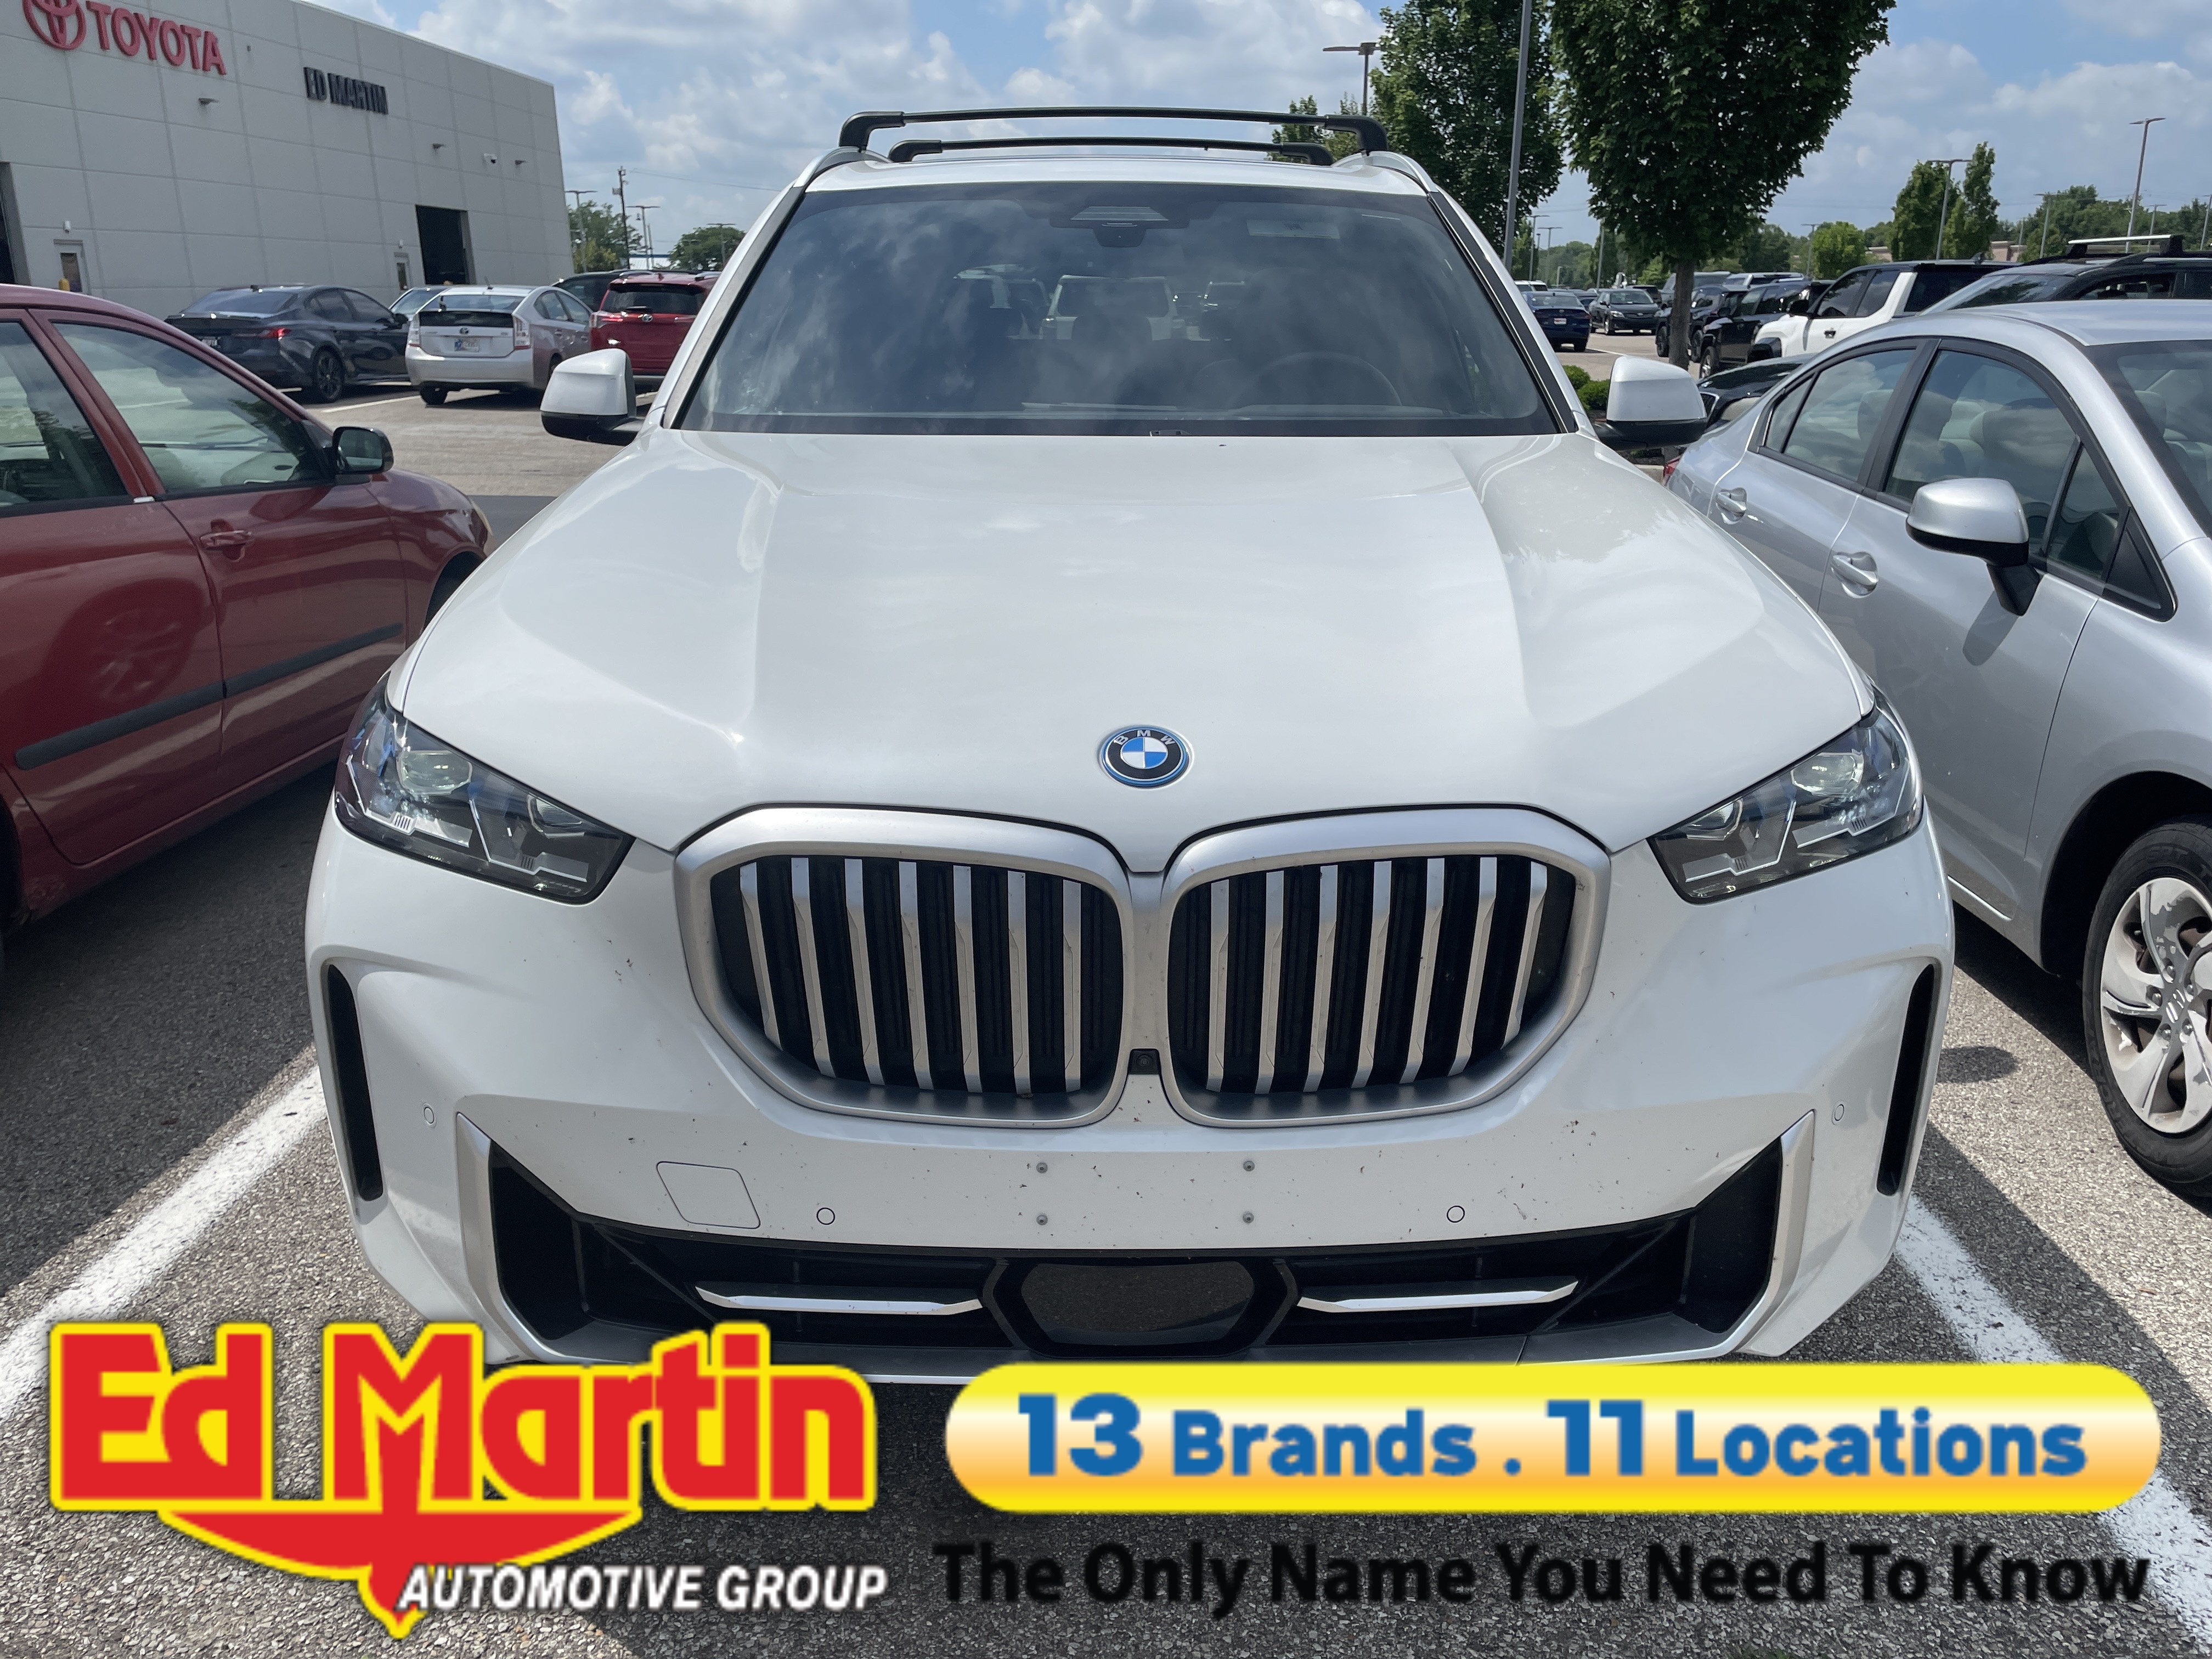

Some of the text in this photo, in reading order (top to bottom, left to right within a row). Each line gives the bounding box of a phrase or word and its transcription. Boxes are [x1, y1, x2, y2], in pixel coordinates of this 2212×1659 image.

[86, 1, 227, 76] TOYOTA
[303, 66, 388, 115] ED MARTIN
[1114, 729, 1175, 745] BMW
